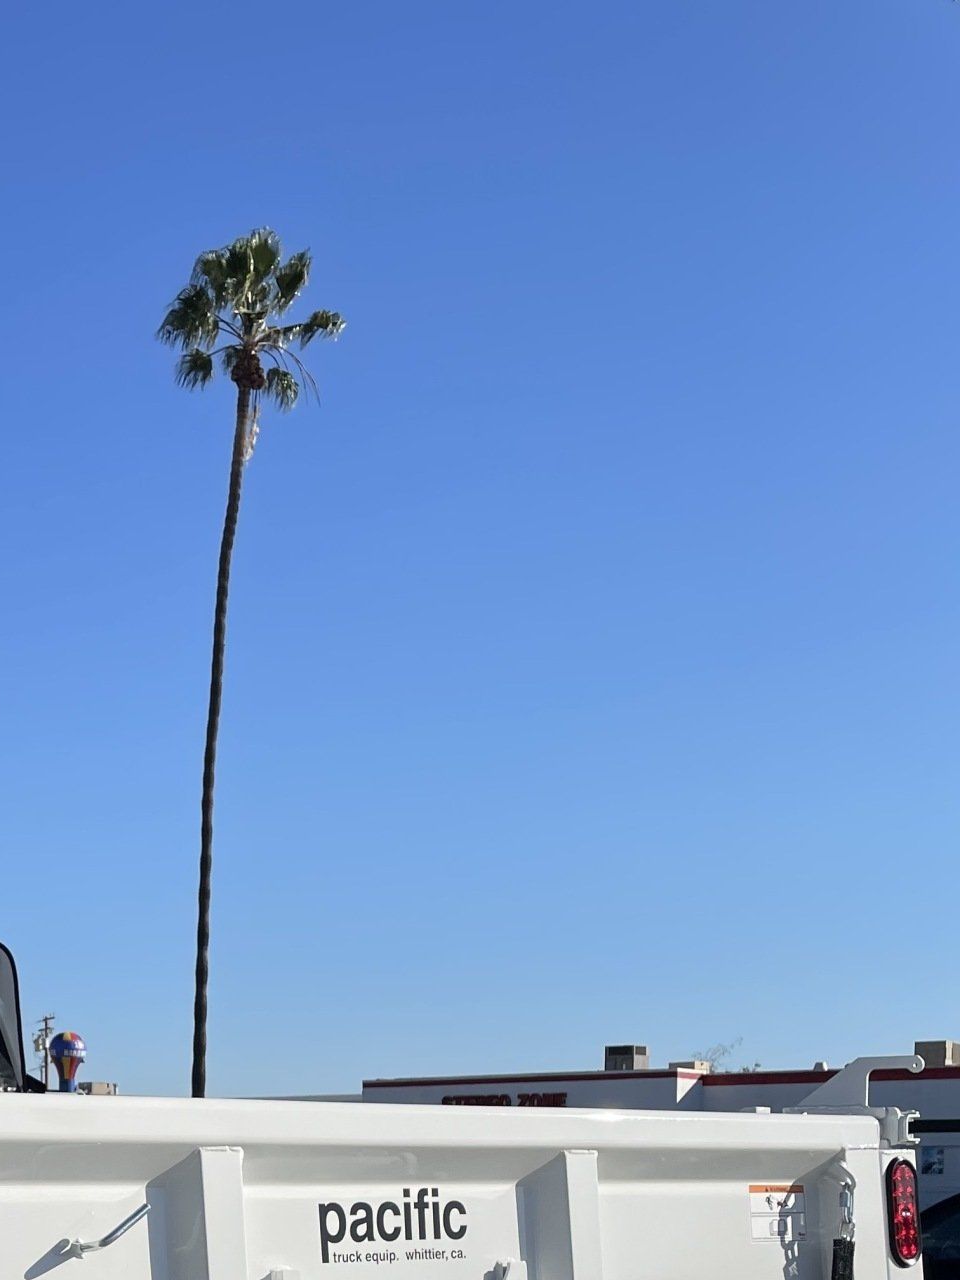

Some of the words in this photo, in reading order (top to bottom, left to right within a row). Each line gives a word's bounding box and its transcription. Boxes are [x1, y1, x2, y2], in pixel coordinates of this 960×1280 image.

[318, 1187, 468, 1264] pacific
[333, 1251, 362, 1263] truck
[365, 1250, 400, 1264] equip.
[405, 1249, 449, 1262] whittier,
[451, 1249, 467, 1260] ca.
